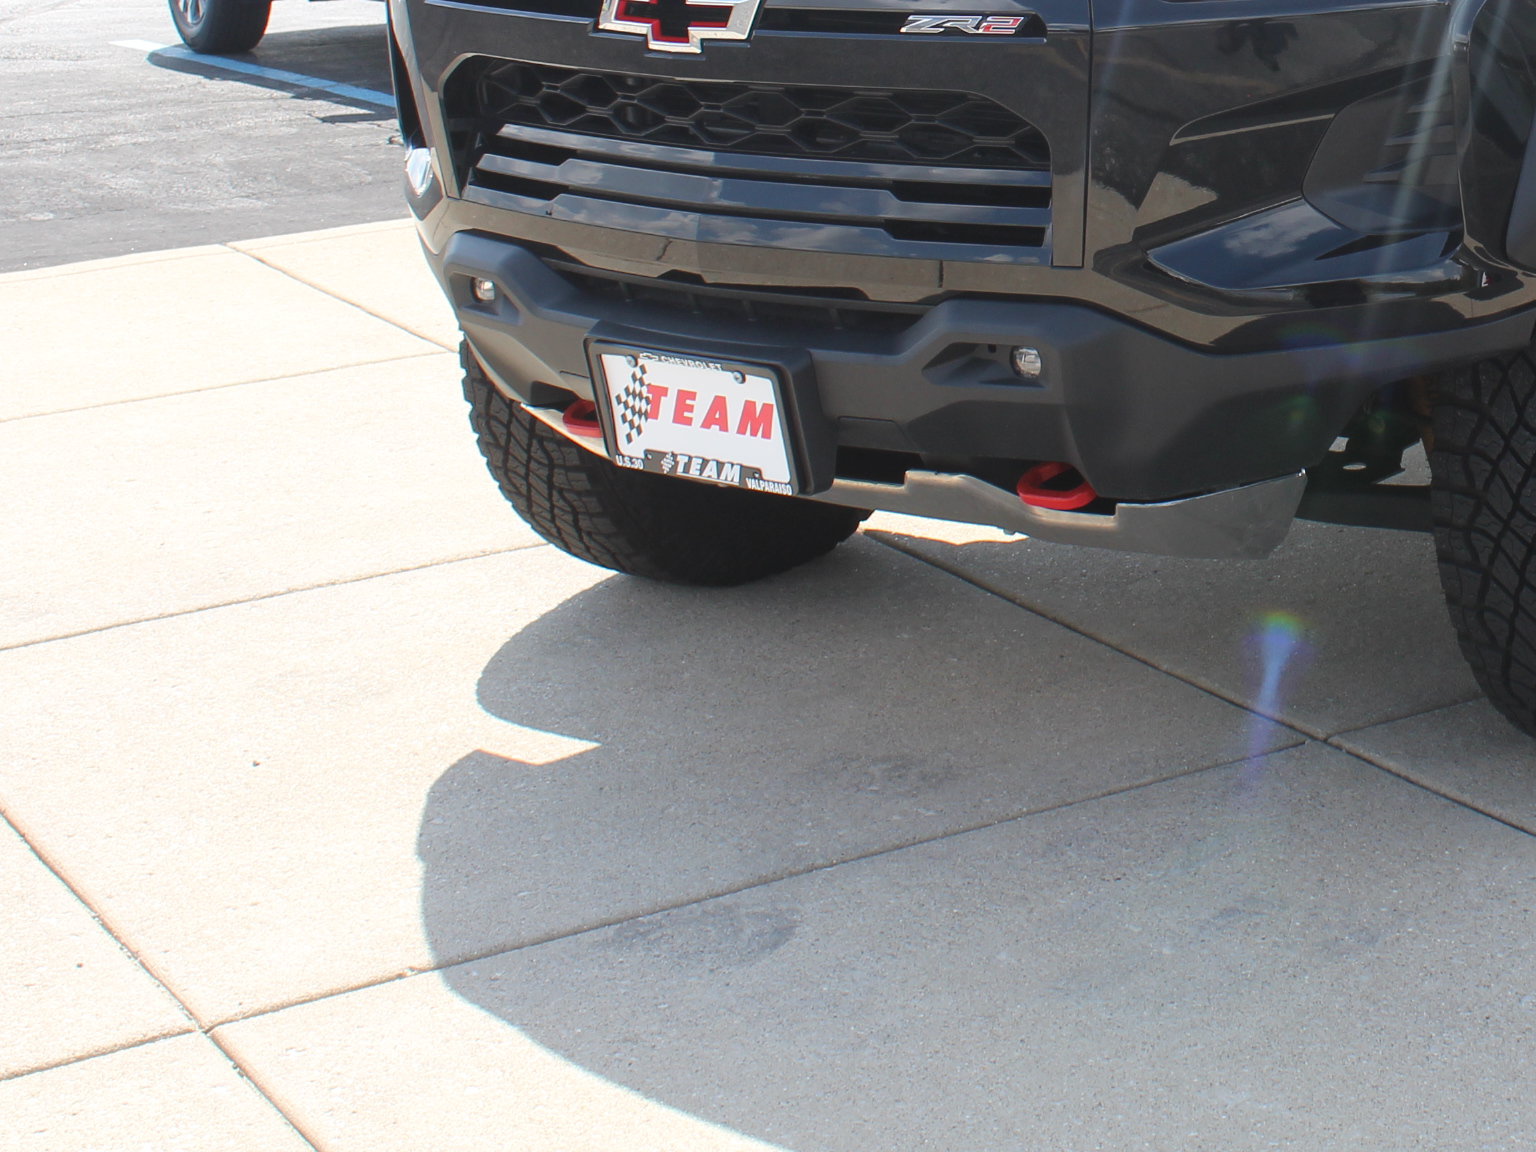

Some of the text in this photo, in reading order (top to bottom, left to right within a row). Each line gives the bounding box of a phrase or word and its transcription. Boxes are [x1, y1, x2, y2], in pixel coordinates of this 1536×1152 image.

[900, 15, 1024, 35] ZR2
[660, 355, 723, 372] CHEVROLET
[646, 383, 775, 440] TEAM
[676, 454, 742, 484] TEAM
[745, 477, 793, 496] VALPARAISO
